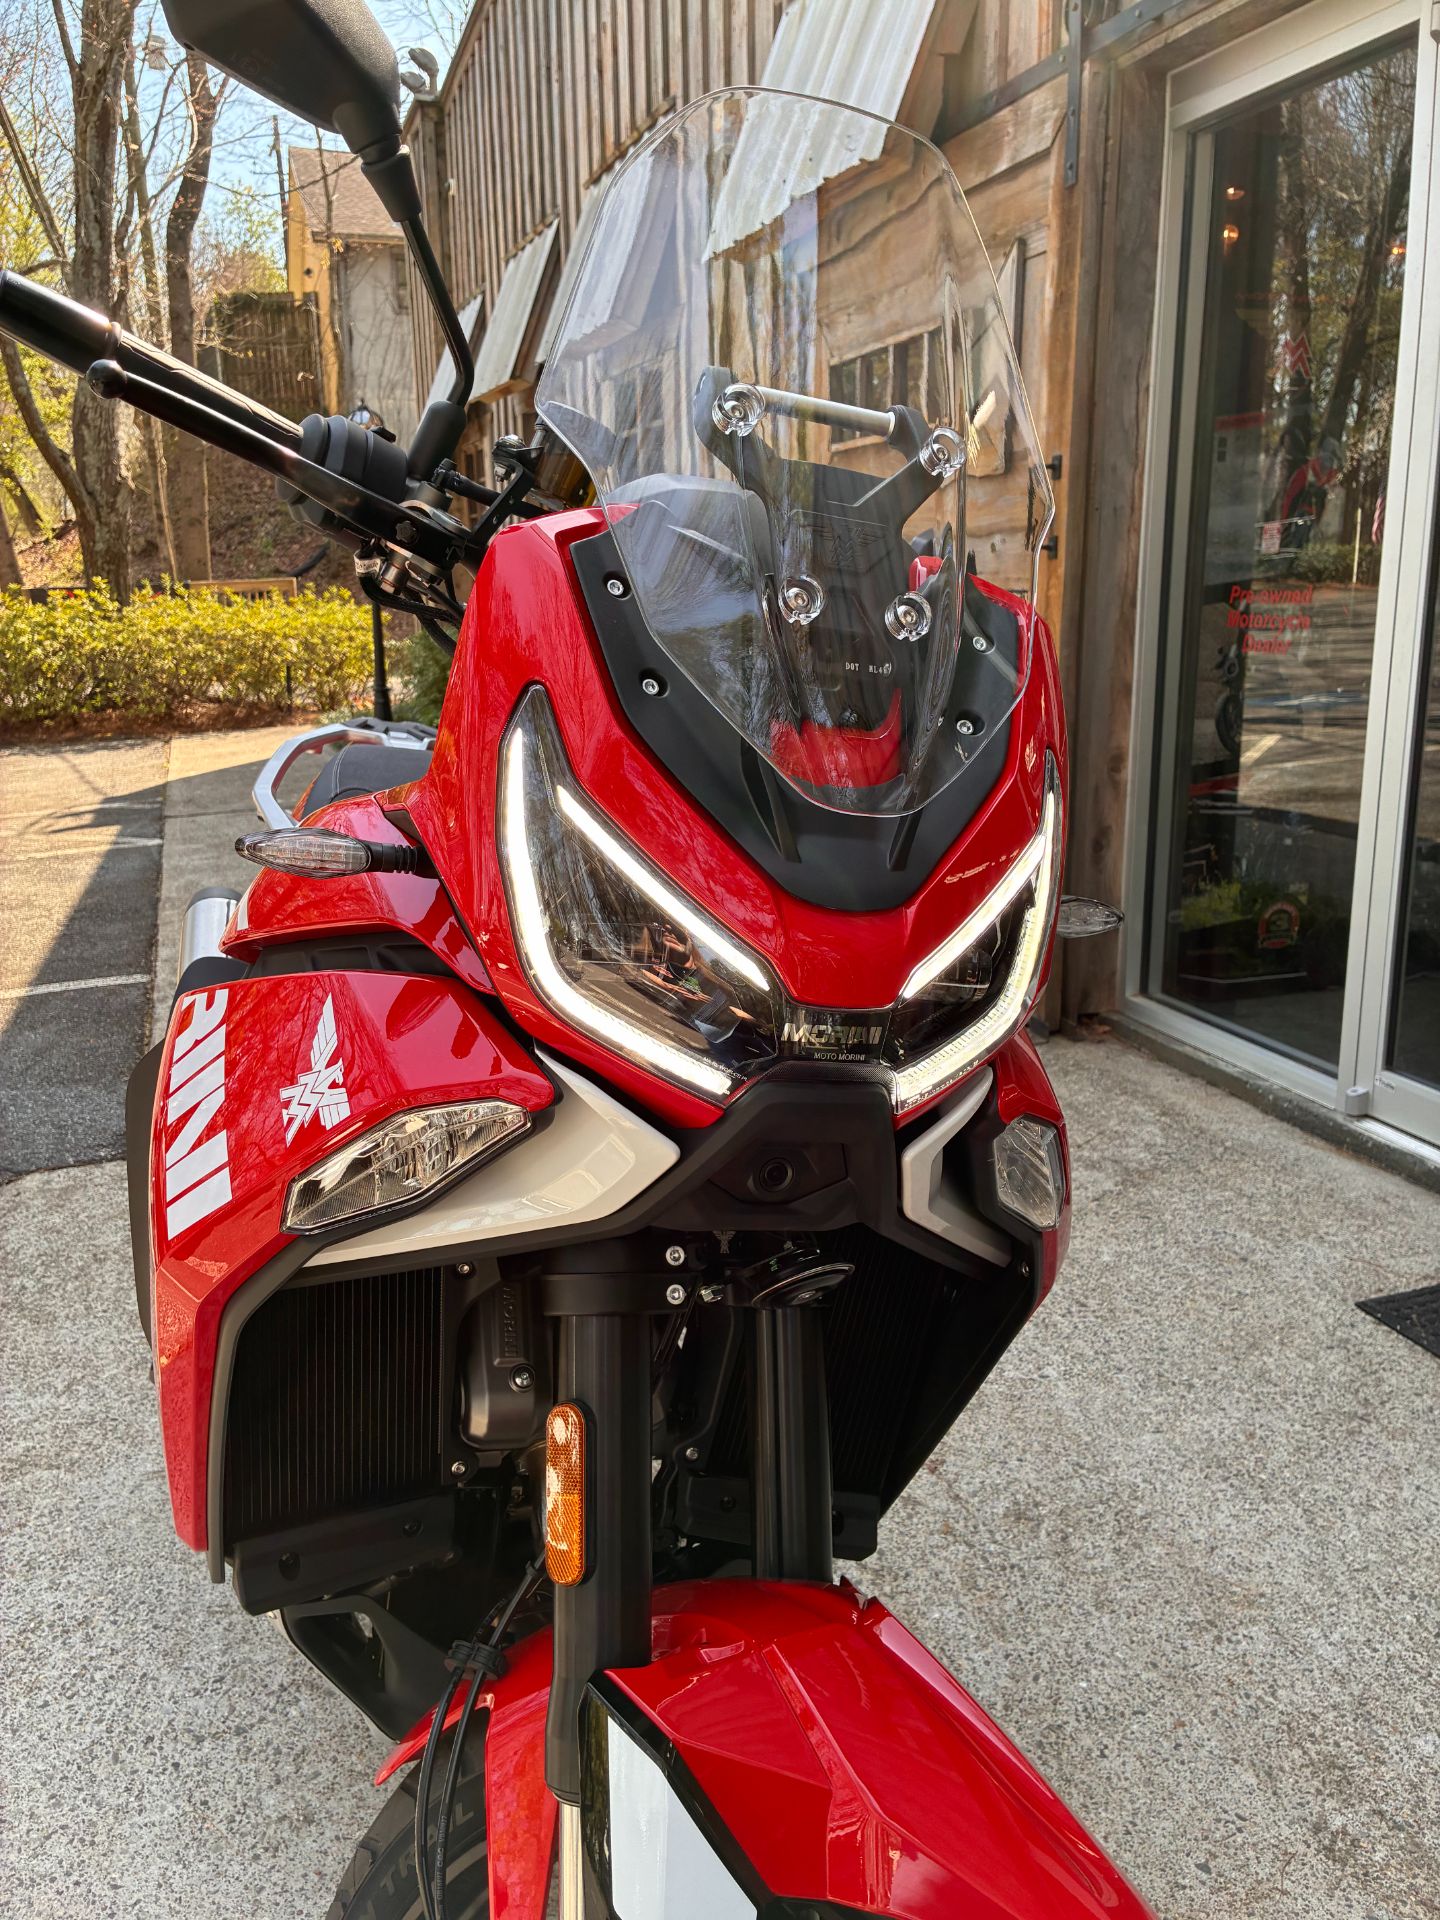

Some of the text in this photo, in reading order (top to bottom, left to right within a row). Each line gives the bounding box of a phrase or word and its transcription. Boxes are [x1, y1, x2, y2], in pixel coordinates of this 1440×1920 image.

[1229, 585, 1313, 605] Pre-owned
[1226, 609, 1310, 634] Motorcycle
[1241, 634, 1291, 656] Dealer
[814, 1052, 865, 1061] MOTO MORINI
